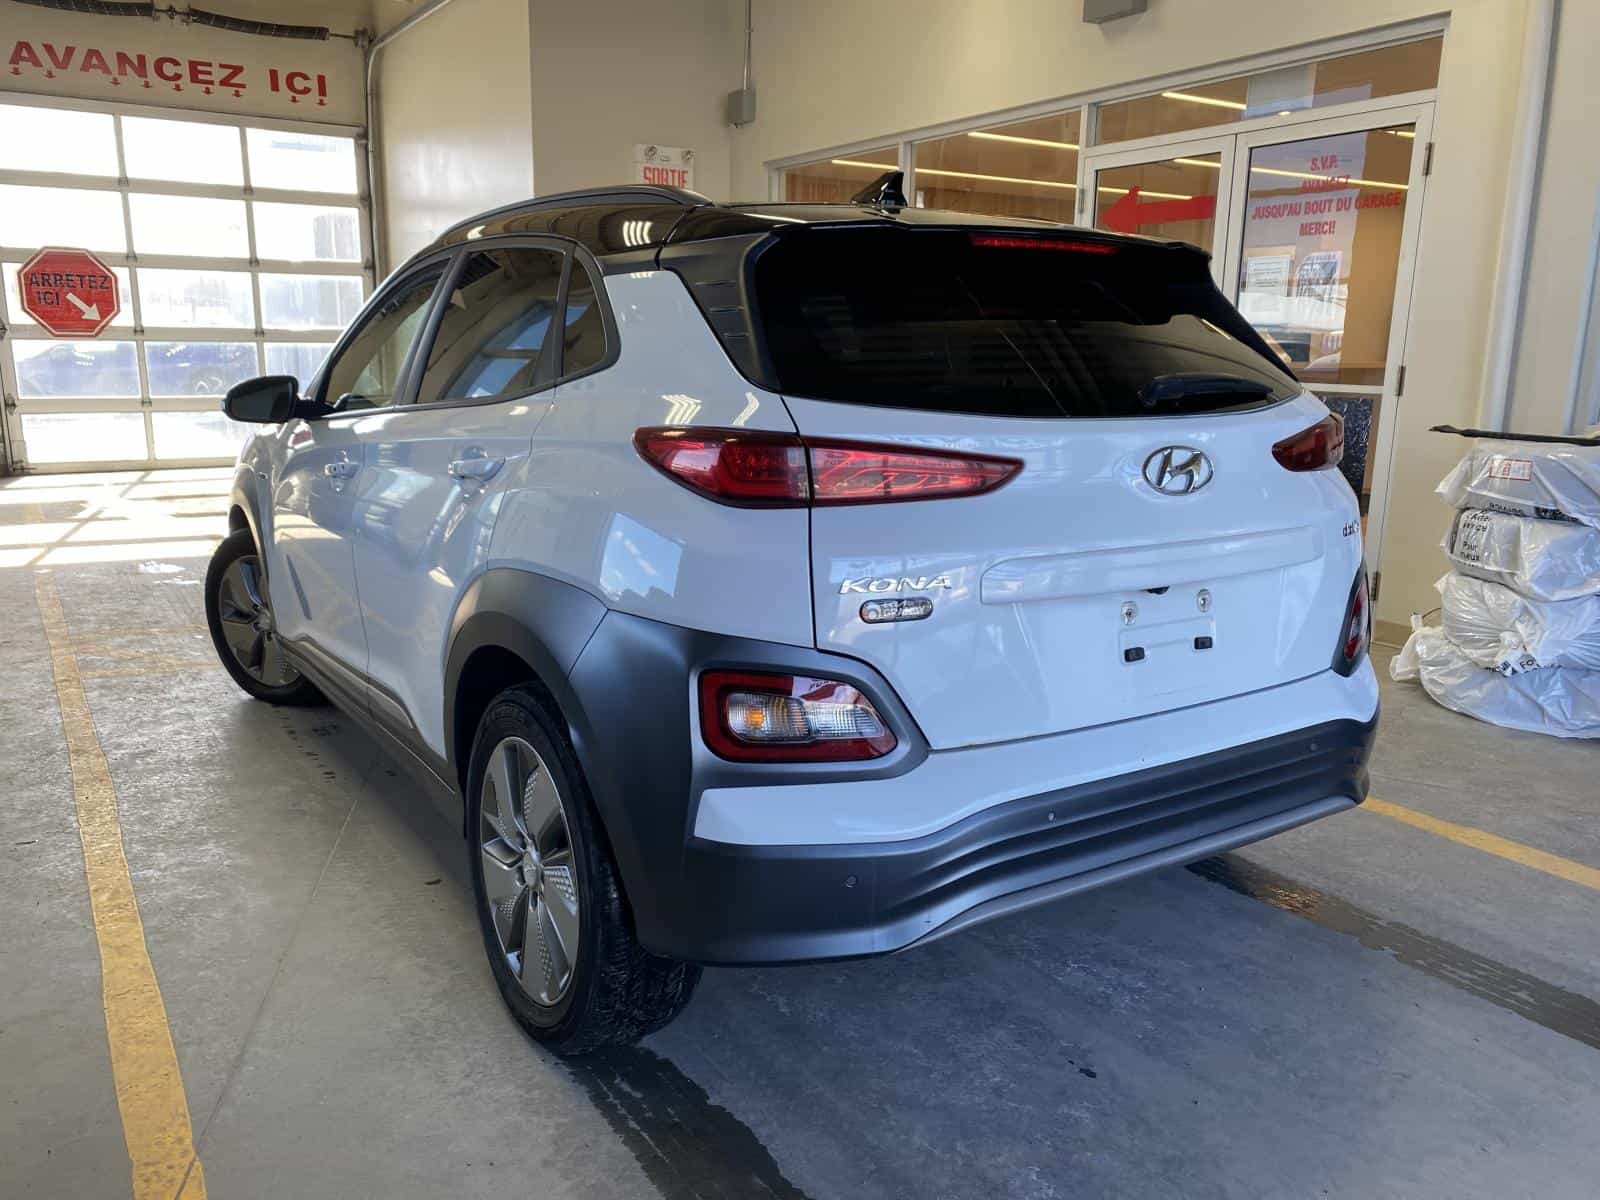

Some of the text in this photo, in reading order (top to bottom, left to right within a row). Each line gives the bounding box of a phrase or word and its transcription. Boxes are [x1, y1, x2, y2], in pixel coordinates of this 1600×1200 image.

[9, 41, 247, 89] AVANCEZ
[643, 166, 689, 188] SORTIE
[1252, 191, 1403, 220] JUSQU'AU BOUT DU GARAGE
[37, 290, 60, 306] ICI
[839, 575, 952, 594] KONA
